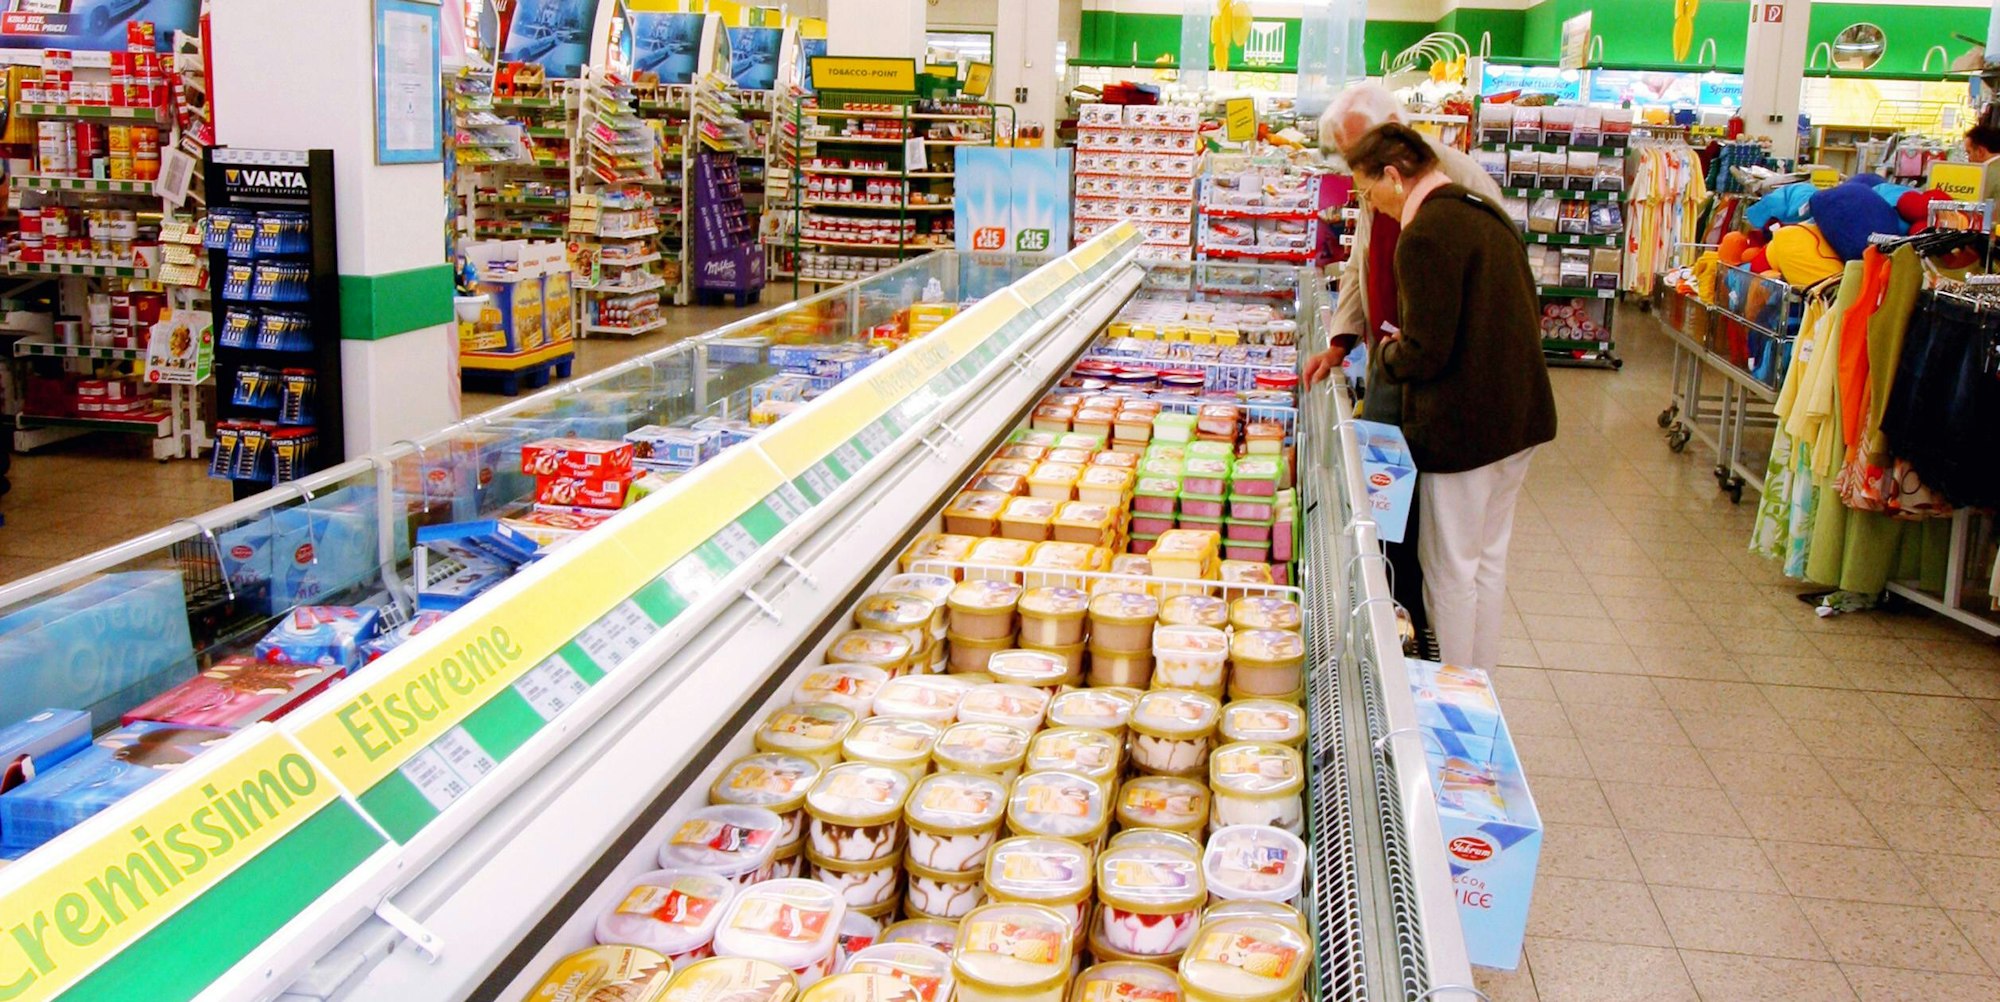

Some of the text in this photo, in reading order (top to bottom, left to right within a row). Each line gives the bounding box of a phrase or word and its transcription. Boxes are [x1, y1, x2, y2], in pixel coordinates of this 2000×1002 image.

[7, 15, 26, 23] KING
[15, 23, 68, 32] SMALL PRICE!
[828, 68, 899, 78] TOBACCO-POINT
[241, 169, 307, 189] VARTA
[1935, 182, 1975, 194] Kissen
[980, 227, 1000, 239] tic
[1023, 229, 1045, 241] tic
[976, 236, 1000, 248] tac
[1020, 237, 1045, 250] tac
[704, 259, 736, 275] Milka
[335, 626, 523, 763] Eiscreme
[1450, 838, 1492, 858] Tekrum
[1462, 889, 1494, 909] ICE
